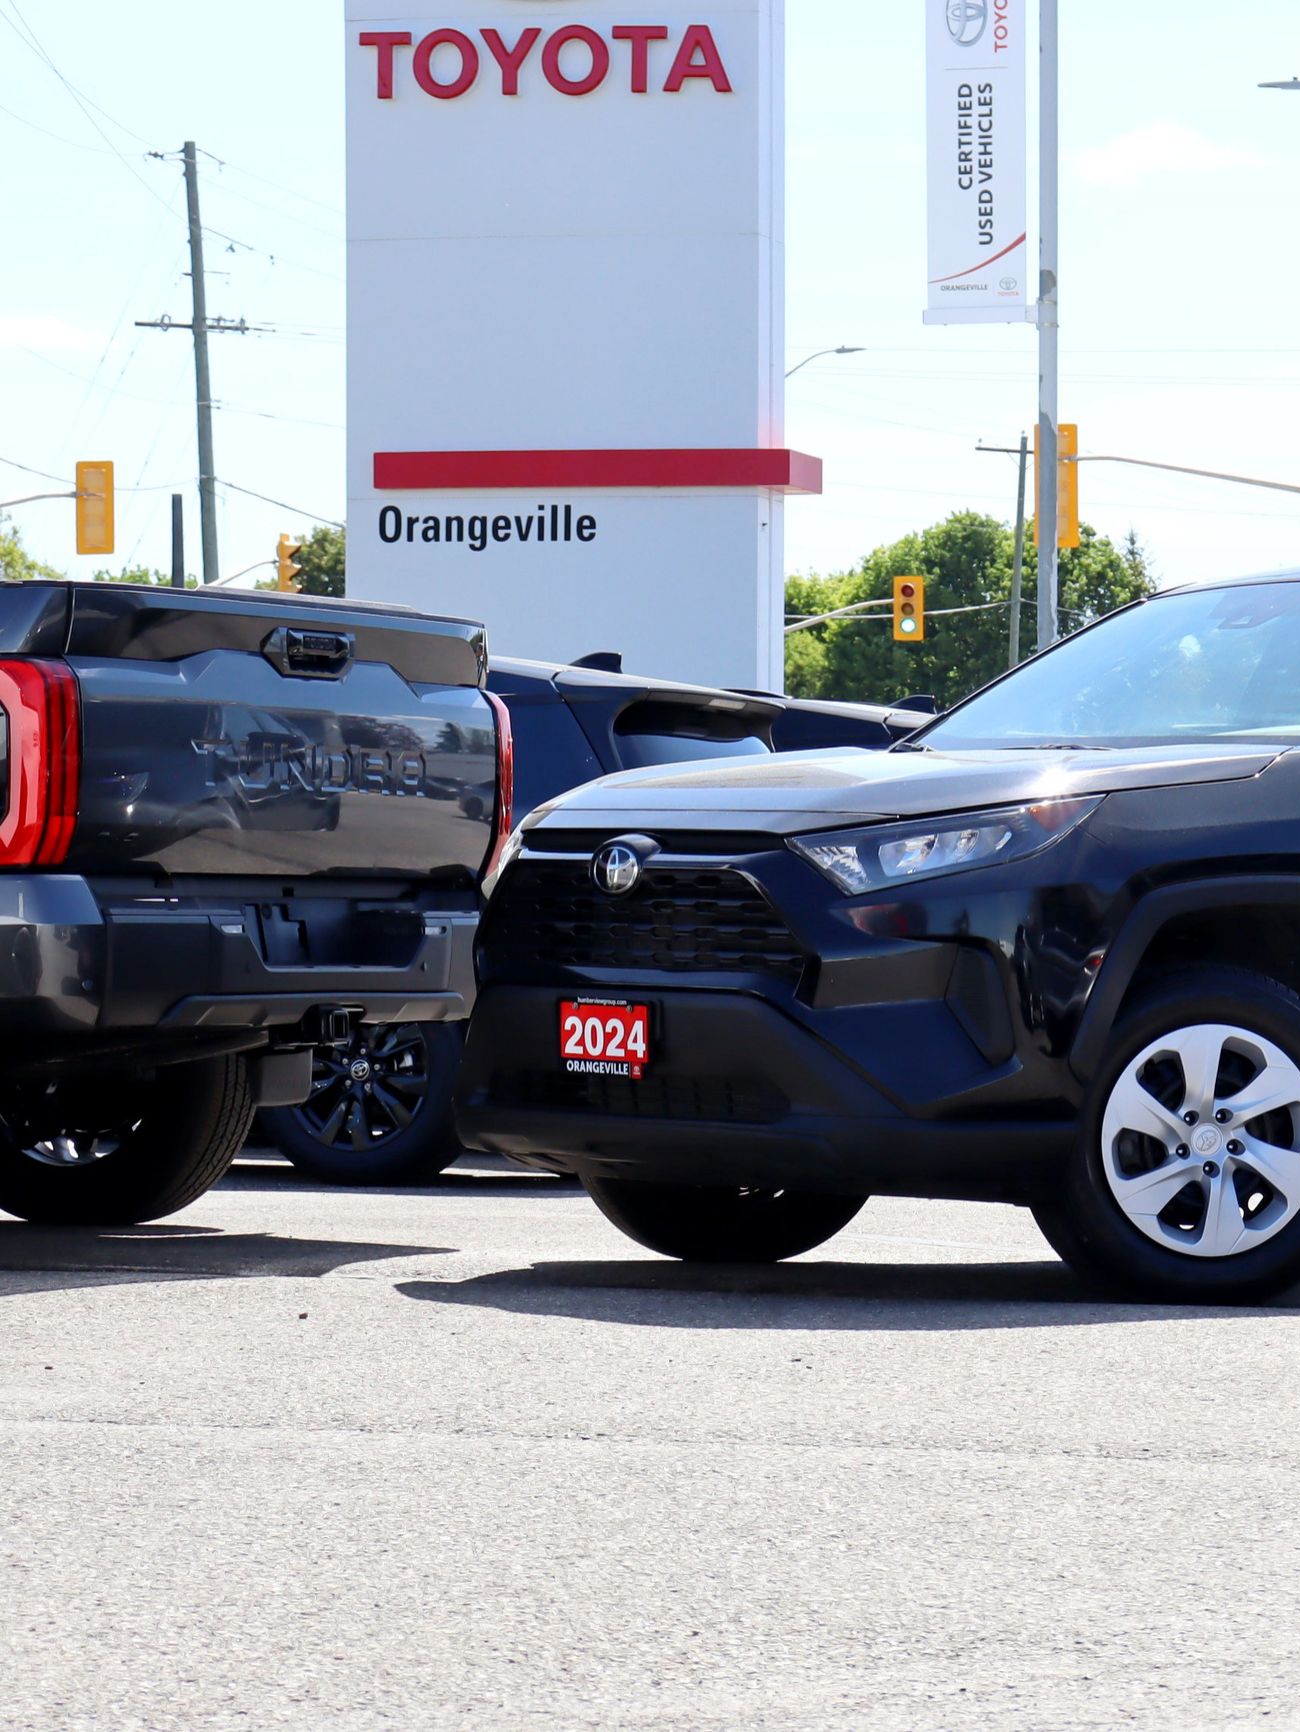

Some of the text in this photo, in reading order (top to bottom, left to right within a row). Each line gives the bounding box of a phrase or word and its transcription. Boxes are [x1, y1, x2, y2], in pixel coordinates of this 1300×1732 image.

[359, 24, 733, 100] TOYOTA
[957, 83, 973, 191] CERTIFIED
[977, 82, 994, 246] USED VEHICLES
[939, 283, 989, 292] ORANGEVILLE
[378, 504, 598, 552] Orangeville
[190, 738, 427, 798] TUNDRA
[564, 1015, 646, 1058] 2024
[566, 1060, 628, 1075] ORANGEVILLE
